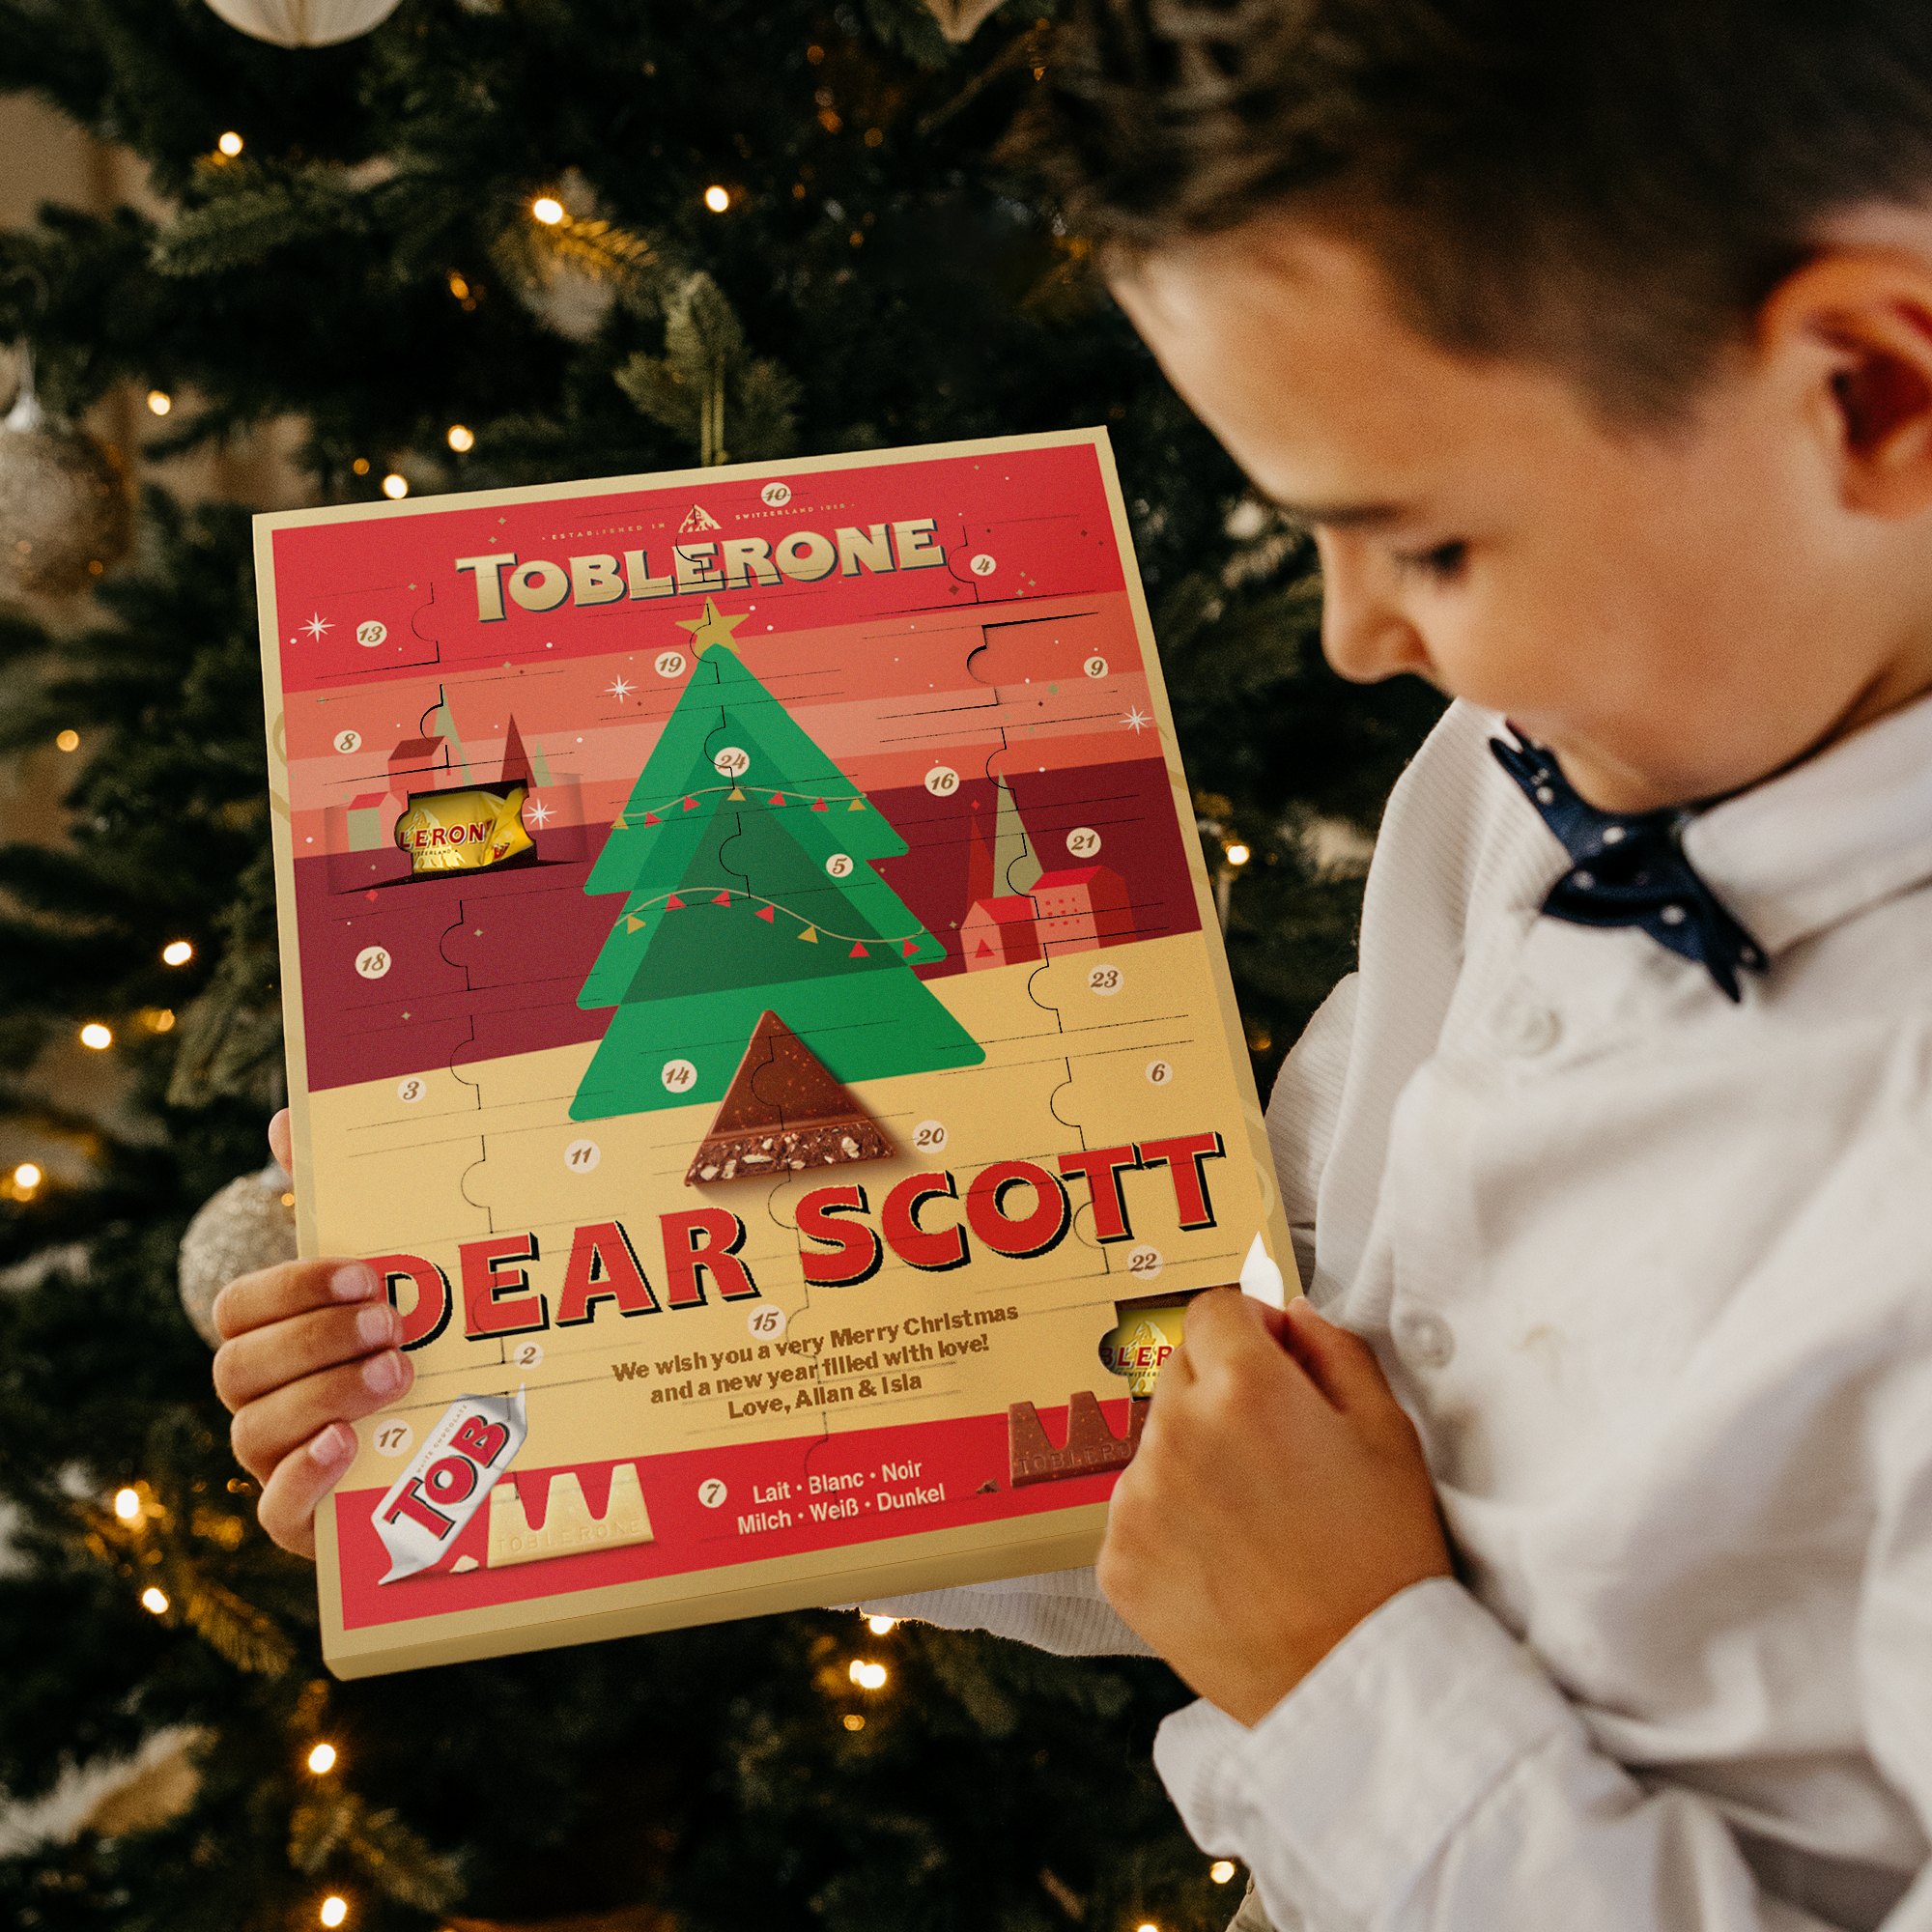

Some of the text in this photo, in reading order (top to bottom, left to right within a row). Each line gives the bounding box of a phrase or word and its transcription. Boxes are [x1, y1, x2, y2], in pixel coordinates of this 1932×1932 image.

[765, 487, 787, 501] 10
[552, 525, 642, 540] ESTABLISHED
[735, 506, 813, 521] SWITZERLAND
[455, 518, 948, 623] TOBLERONE
[977, 557, 991, 573] 4
[358, 625, 384, 642] 13
[658, 656, 682, 673] 19
[1091, 659, 1104, 676] 9
[340, 732, 356, 752] 8
[718, 753, 747, 770] 24
[930, 773, 954, 791] 16
[399, 818, 494, 849] LERON
[1071, 834, 1096, 850] 21
[832, 857, 848, 875] 5
[361, 952, 386, 972] 18
[1090, 970, 1120, 988] 23
[666, 1066, 690, 1086] 14
[1151, 1064, 1165, 1082] 6
[402, 1080, 420, 1101] 3
[917, 1126, 945, 1147] 20
[570, 1147, 593, 1166] 11
[358, 1130, 1226, 1351] DEAR SCOTT
[1130, 1253, 1157, 1272] 22
[753, 1311, 780, 1332] 15
[611, 1306, 1019, 1382] We wish you a very Merry Christmas
[520, 1347, 537, 1365] 2
[650, 1334, 989, 1404] and a new year filled with love!
[727, 1373, 923, 1420] Love, Allan & Isla
[379, 1428, 407, 1449] 17
[382, 1414, 511, 1541] TOB
[753, 1460, 923, 1505] Lait Blanc Noir
[707, 1483, 721, 1504] 7
[737, 1483, 947, 1536] Milch Weiß Dunkel
[497, 1519, 642, 1553] TOBLERONE
